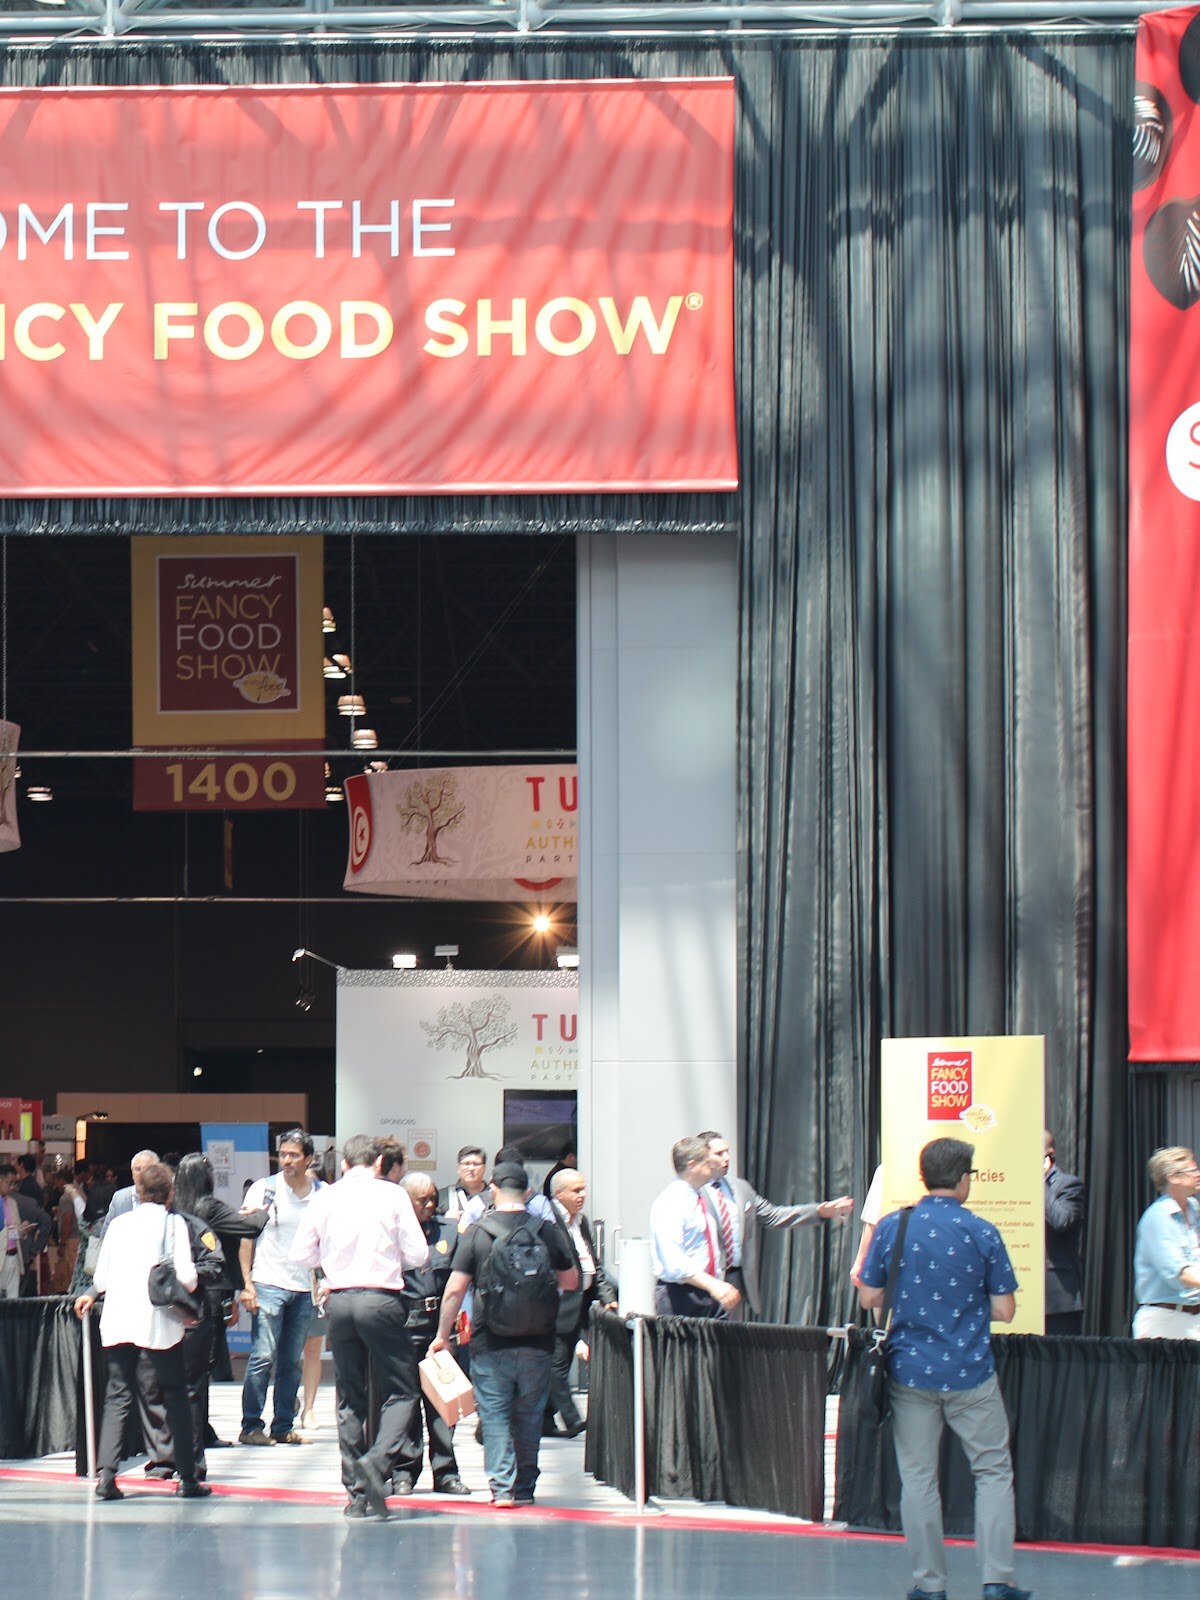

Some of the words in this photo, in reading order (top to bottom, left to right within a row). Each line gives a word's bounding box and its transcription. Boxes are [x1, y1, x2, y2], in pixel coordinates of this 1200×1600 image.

[159, 200, 267, 260] TO
[296, 198, 457, 259] THE
[154, 299, 394, 361] FOOD
[176, 573, 282, 590] Summer
[175, 594, 281, 620] FANCY
[176, 623, 281, 651] FOOD
[175, 653, 281, 680] SHOW
[165, 762, 297, 802] 1400
[931, 1067, 968, 1080] FANCY
[931, 1080, 968, 1095] FOOD
[931, 1094, 968, 1108] SHOW
